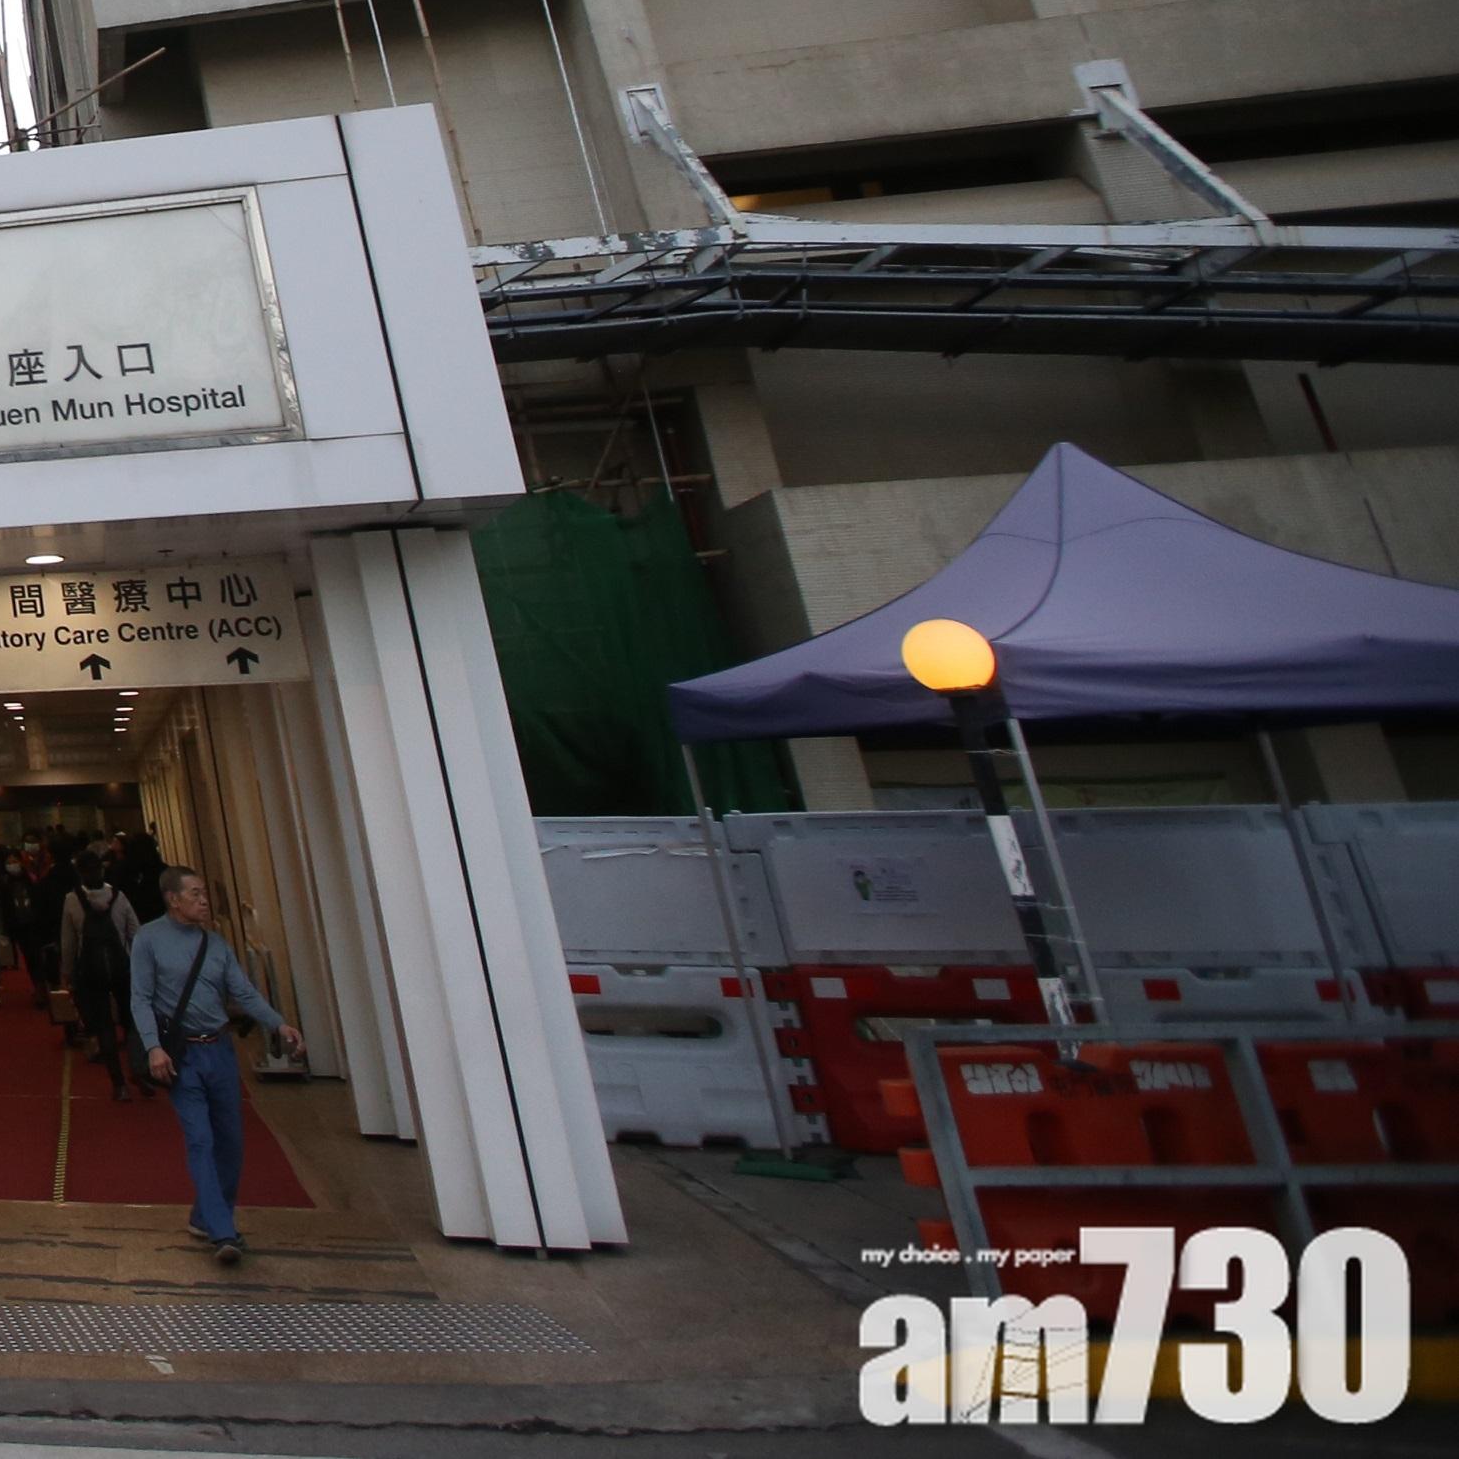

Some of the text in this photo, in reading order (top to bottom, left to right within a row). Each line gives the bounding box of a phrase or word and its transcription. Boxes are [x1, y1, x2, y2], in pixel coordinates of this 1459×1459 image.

[51, 398, 114, 422] Mun
[125, 384, 247, 417] Hospital
[54, 625, 110, 645] Care
[117, 621, 199, 642] Centre
[208, 615, 282, 643] (ACC)
